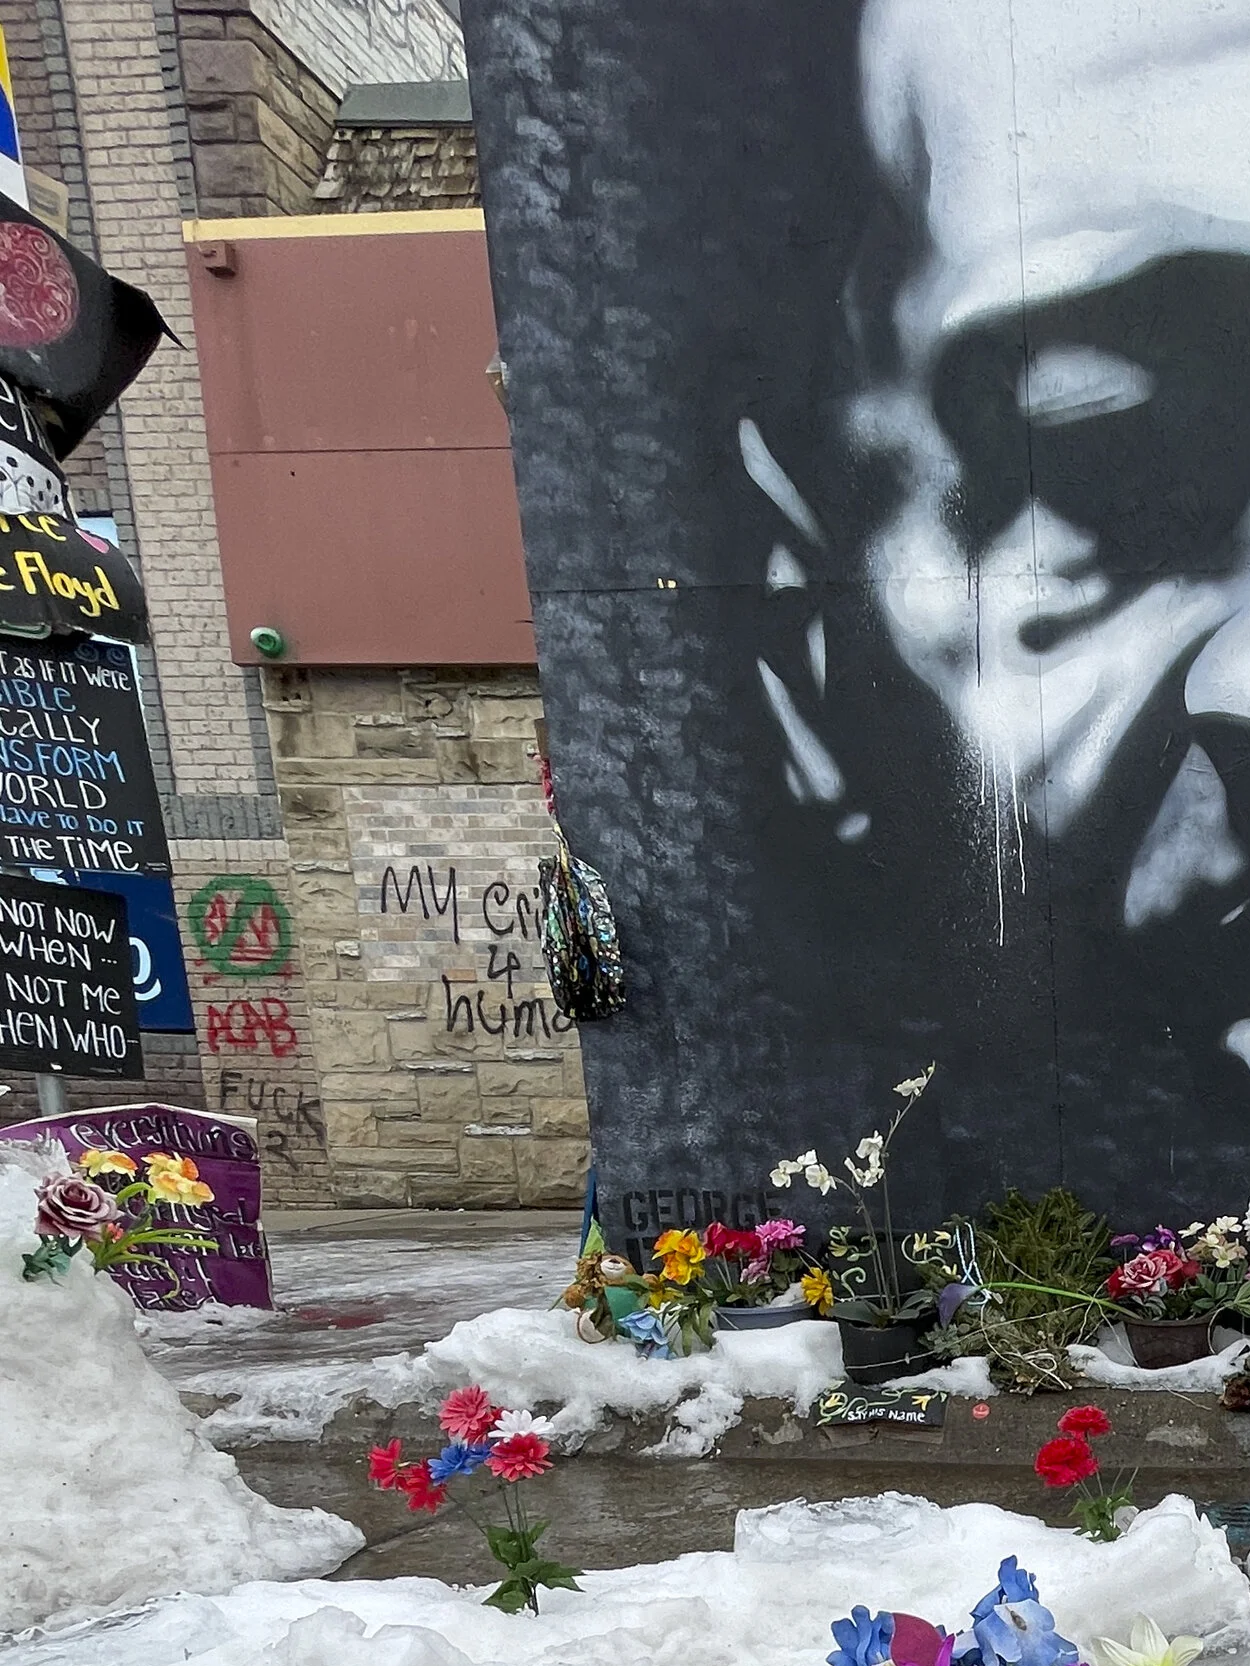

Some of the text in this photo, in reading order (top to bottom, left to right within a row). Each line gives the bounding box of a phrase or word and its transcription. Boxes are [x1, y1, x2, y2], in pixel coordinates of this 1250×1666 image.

[14, 551, 120, 617] Floyd
[39, 659, 57, 683] IF
[61, 661, 78, 685] IT
[0, 772, 107, 810] ORLD
[55, 813, 79, 830] TO
[87, 815, 118, 835] DO
[127, 820, 144, 836] IT
[55, 906, 116, 944] NOW
[5, 972, 68, 1008] NOT
[207, 997, 297, 1059] ACAB
[220, 1071, 328, 1145] FUCK
[622, 1188, 785, 1232] GEORGE
